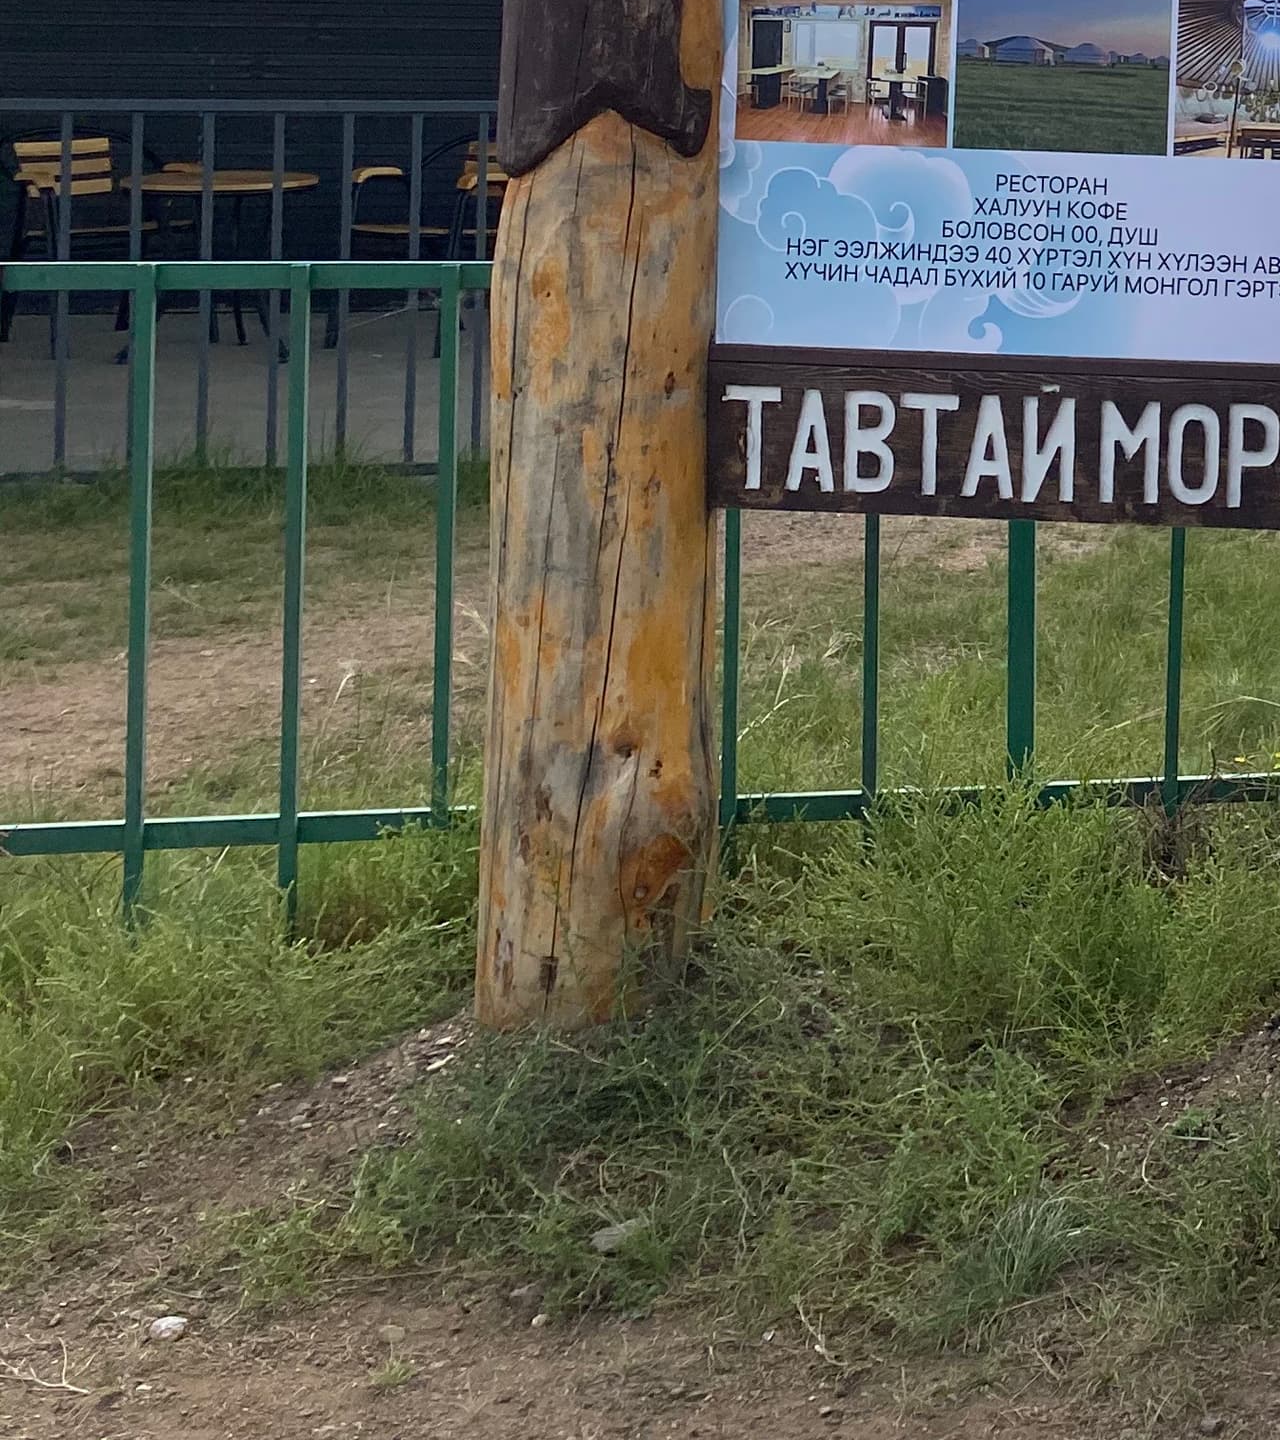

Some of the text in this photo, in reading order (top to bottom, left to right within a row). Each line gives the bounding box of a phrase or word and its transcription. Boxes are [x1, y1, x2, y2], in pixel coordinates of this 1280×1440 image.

[996, 174, 1107, 196] РЕСТОРАН
[974, 197, 1128, 221] ХАЛУУН КОФЕ
[942, 220, 1065, 243] БОЛОВСОН
[1107, 226, 1158, 248] ДУШ
[786, 237, 829, 257] НЭГ
[834, 239, 979, 265] ЭЭЛЖИНДЭЭ
[984, 246, 1012, 265] 40
[1017, 247, 1102, 268] ХҮРТЭЛ
[1107, 250, 1151, 270] ХҮН
[1157, 252, 1247, 274] ХҮЛЭЭН
[785, 261, 858, 283] ХҮЧИН
[865, 265, 938, 288] ЧАДАЛ
[944, 266, 1016, 289] БҮХИЙ
[1022, 271, 1046, 290] 10
[1052, 270, 1118, 293] ГАРУЙ
[1125, 275, 1218, 297] МОНГОЛ
[722, 385, 1075, 502] ТАВТАЙ
